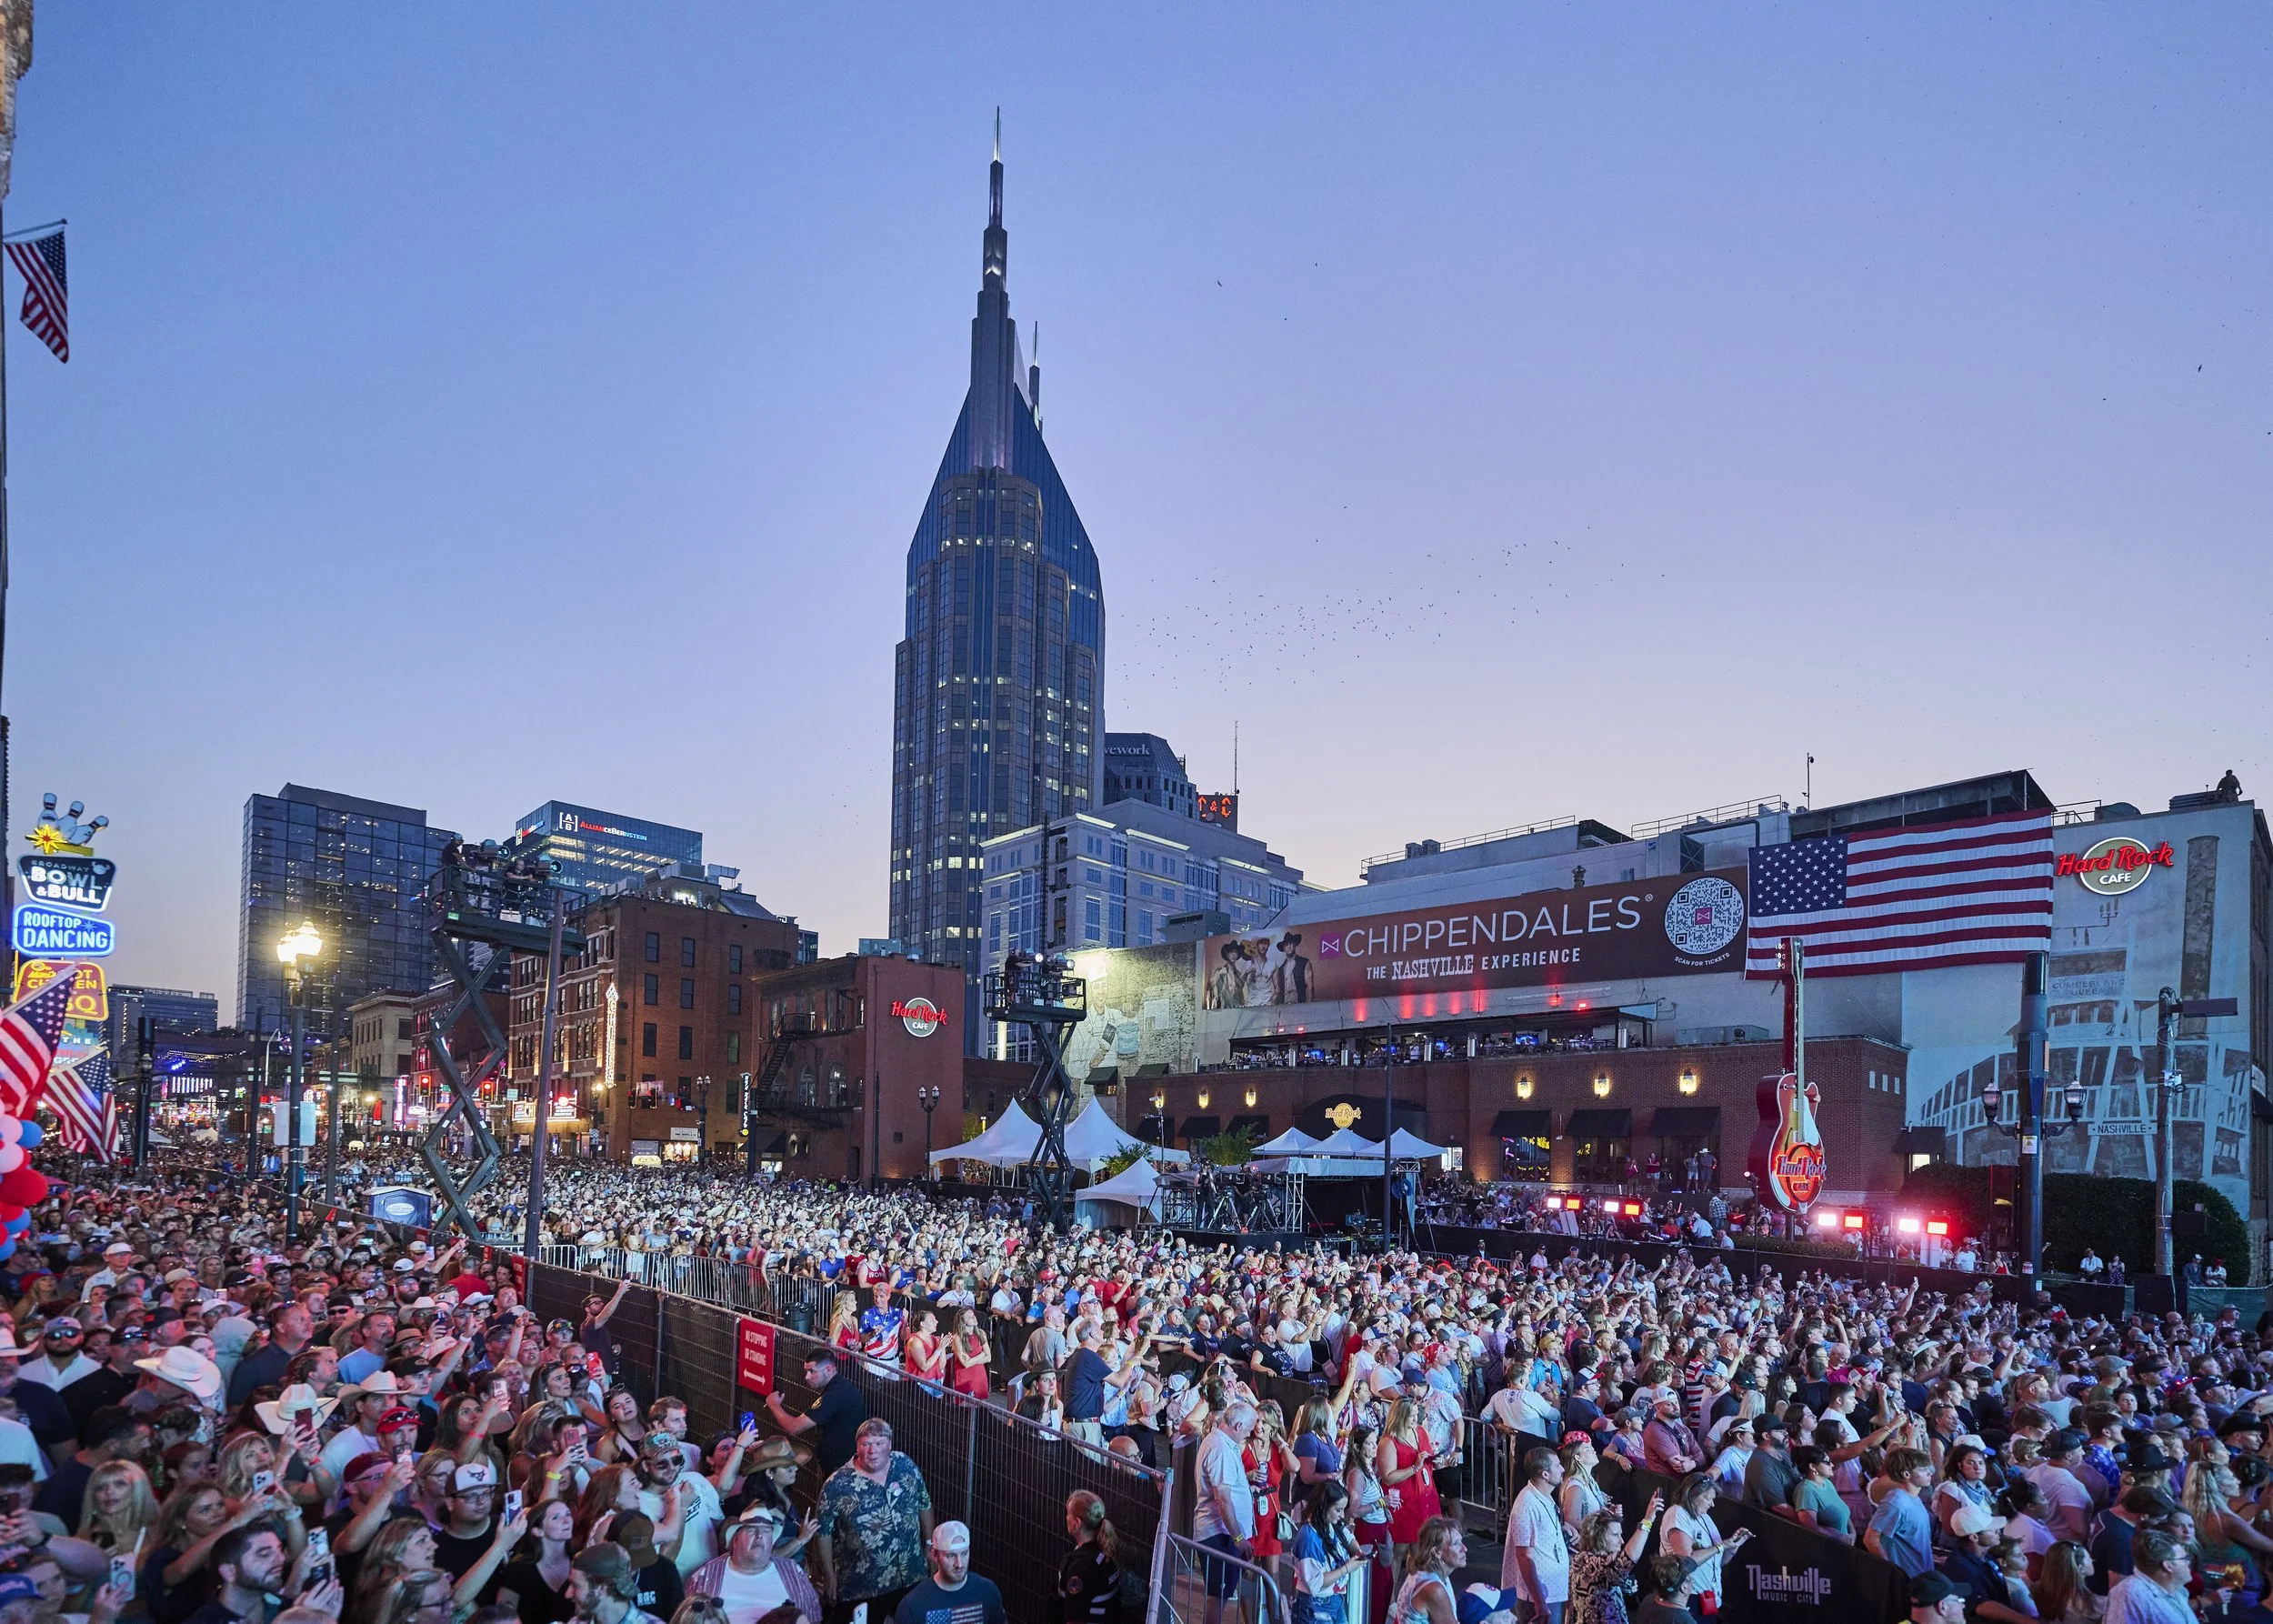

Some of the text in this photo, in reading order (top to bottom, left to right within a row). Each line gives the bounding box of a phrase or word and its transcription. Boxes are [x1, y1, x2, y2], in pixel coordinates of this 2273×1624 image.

[31, 860, 89, 873] BROADWAY
[2057, 840, 2174, 877] Hard Rock
[31, 866, 103, 890] BOWL
[2098, 872, 2132, 885] CAFE
[24, 911, 82, 928] ROOFTOP
[1345, 896, 1641, 957] CHIPPENDALES
[23, 927, 108, 948] DANCING
[1367, 947, 1580, 981] THE NASHVILLE EXPERIENCE
[1674, 956, 1690, 965] SCAN
[1705, 952, 1730, 965] TICKETS
[891, 1000, 948, 1026] Hard Rock
[912, 1022, 928, 1030] CAFE
[1326, 1108, 1361, 1119] Hard Rock
[2098, 1124, 2147, 1134] NASHVILLE
[1777, 1155, 1827, 1180] Hard Rock
[1763, 1591, 1813, 1604] MUSIC CITY
